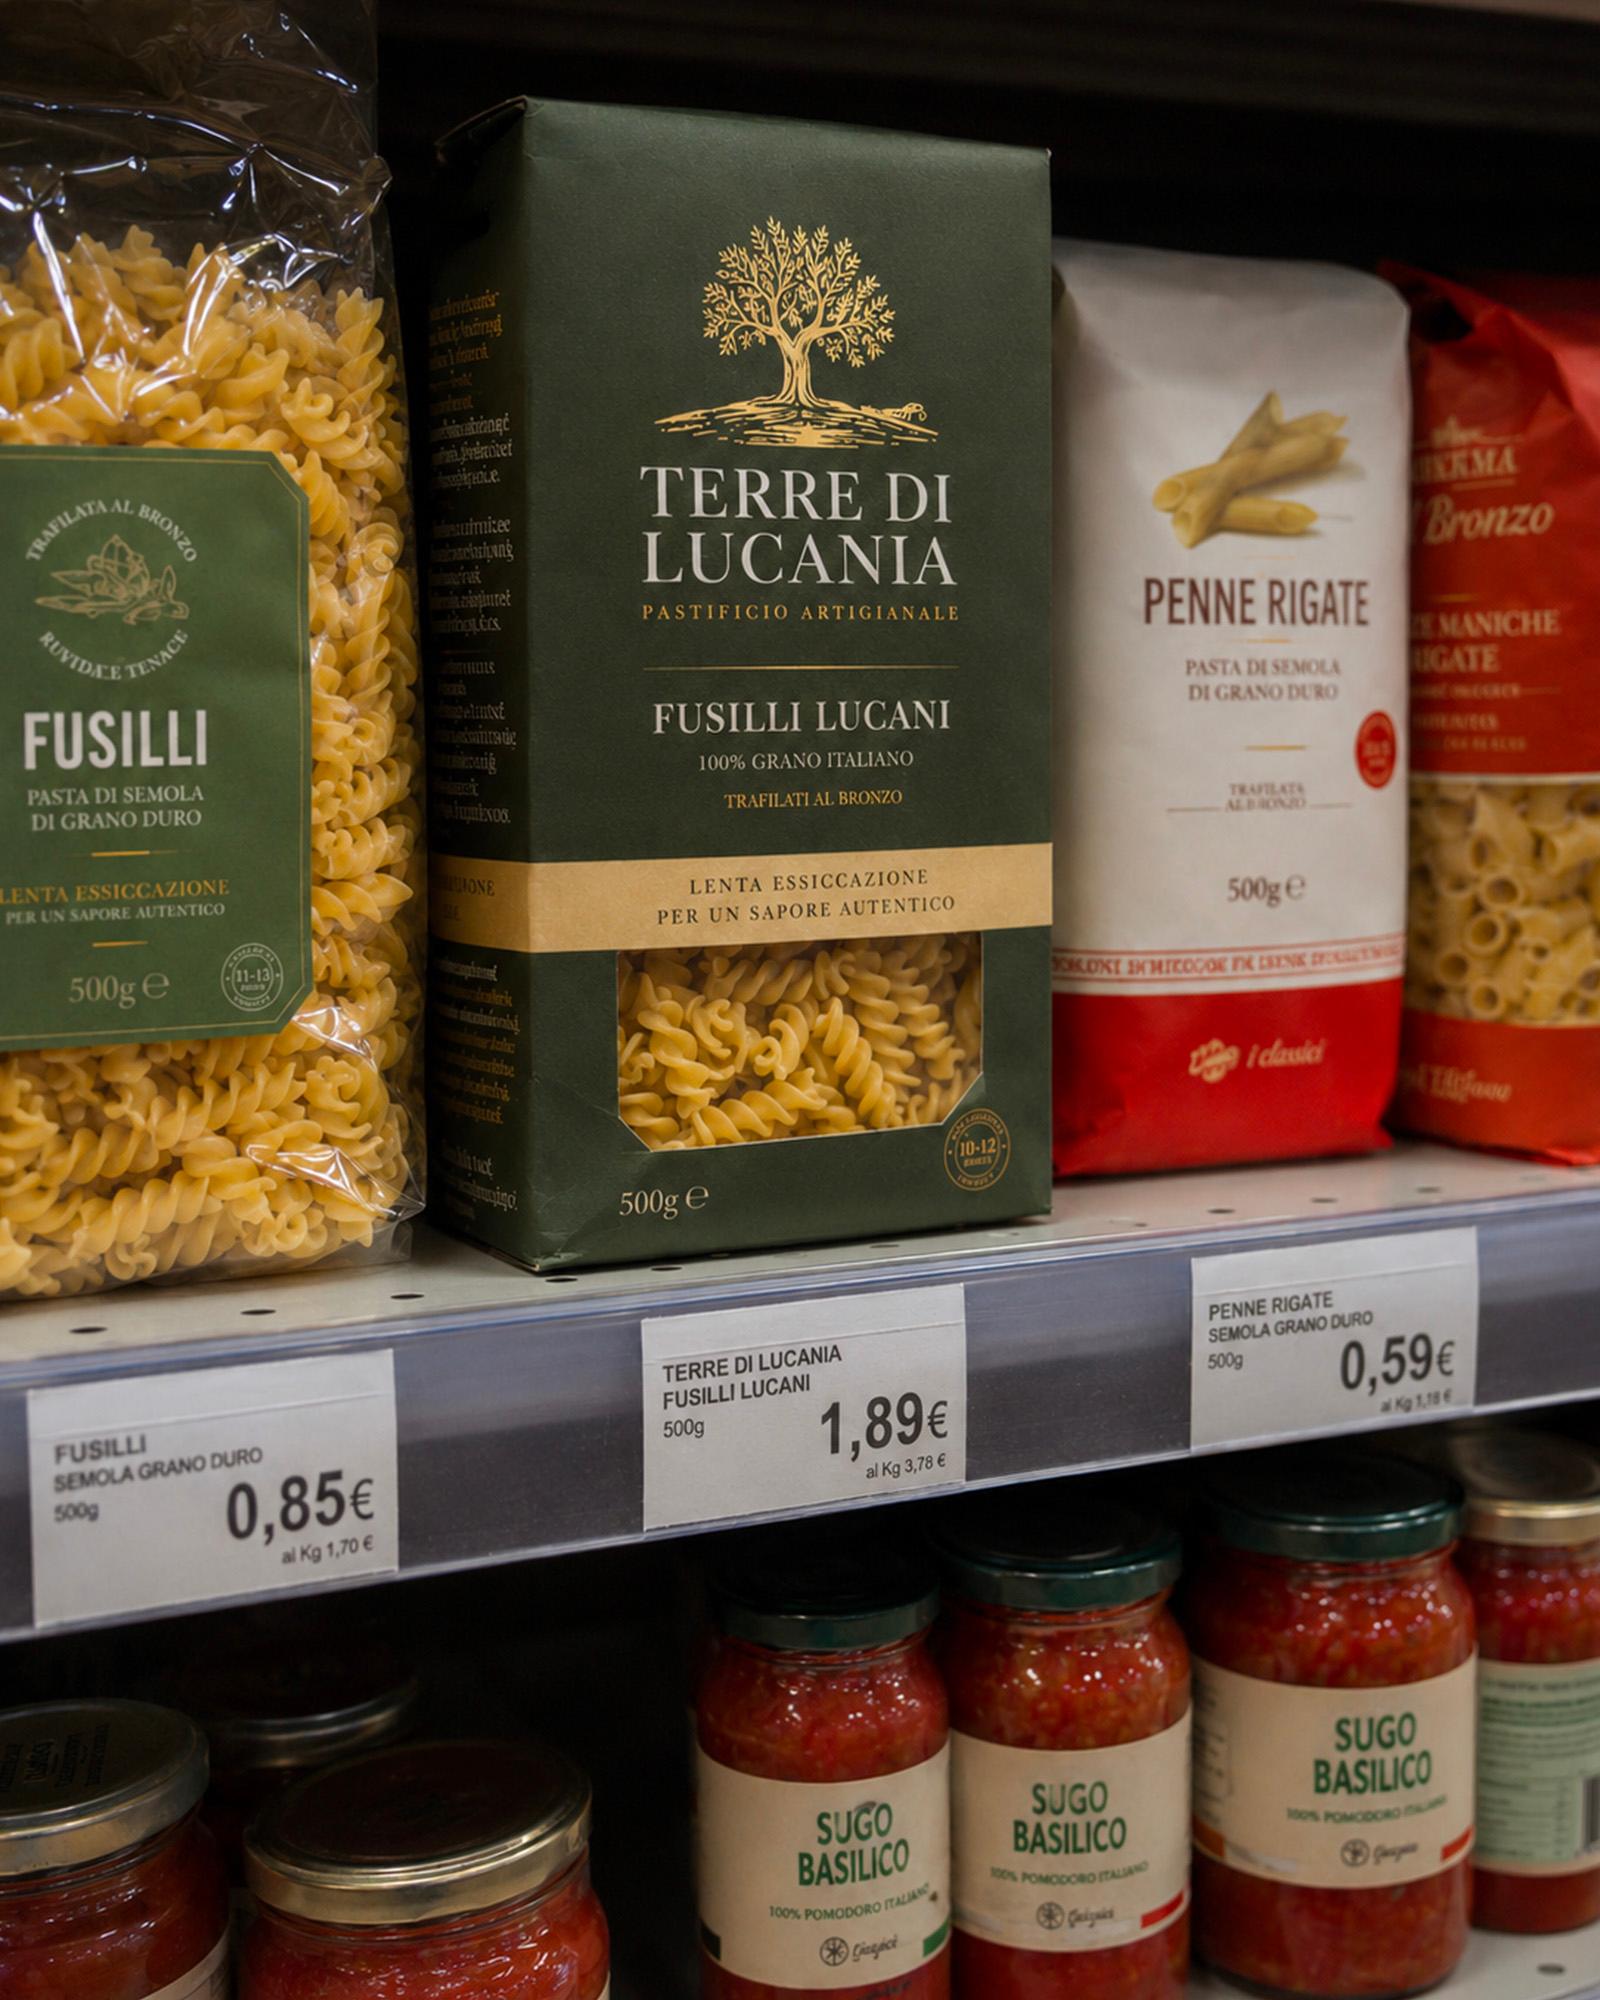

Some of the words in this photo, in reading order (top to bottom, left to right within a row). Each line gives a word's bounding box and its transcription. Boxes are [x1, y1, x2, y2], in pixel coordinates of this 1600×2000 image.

[640, 466, 863, 521] TERRE
[885, 473, 952, 523] DI
[26, 499, 108, 561] TRAFILATA
[110, 499, 134, 514] AL
[138, 504, 197, 562] BRONZO
[1424, 493, 1554, 545] Bronzo
[642, 531, 958, 586] LUCANIA
[642, 604, 789, 620] PASTIFICIO
[801, 605, 959, 621] ARTIGIANALE
[1144, 577, 1256, 626] PENNE
[1268, 579, 1370, 626] RIGATE
[1438, 609, 1562, 639] MANICHE
[125, 629, 188, 680] TENACE
[1185, 659, 1242, 676] PASTA
[1247, 659, 1268, 675] DI
[1271, 658, 1341, 675] SEMOLA
[1188, 684, 1210, 701] DI
[1214, 684, 1283, 701] GRANO
[1287, 683, 1339, 700] DURO
[653, 701, 801, 734] FUSILLI
[816, 699, 950, 732] LUCANI
[24, 709, 207, 770] FUSILLI
[699, 753, 746, 772] 100%
[751, 752, 822, 770] GRANO
[827, 750, 914, 769] ITALIANO
[27, 787, 89, 806] PASTA
[95, 787, 117, 804] DI
[123, 785, 204, 804] SEMOLA
[724, 791, 809, 810] TRAFILATI
[814, 791, 835, 807] AL
[838, 789, 903, 806] BRONZO
[31, 813, 54, 831] DI
[61, 811, 137, 829] GRANO
[142, 808, 202, 826] DURO
[0, 886, 68, 904] LENTA
[76, 879, 230, 901] ESSICCAZIONE
[689, 878, 762, 895] LENTA
[773, 868, 928, 892] ESSICCAZIONE
[1227, 876, 1281, 908] 500g
[6, 911, 37, 925] PER
[42, 909, 65, 923] UN
[70, 906, 131, 922] SAPORE
[135, 903, 225, 919] AUTENTICO
[657, 907, 699, 925] PER
[709, 906, 740, 923] UN
[750, 902, 831, 922] SAPORE
[839, 895, 955, 916] AUTENTICO
[69, 976, 136, 1009] 500g
[619, 1188, 679, 1220] 500g
[1208, 1299, 1267, 1321] PENNE
[1272, 1291, 1334, 1314] RIGATE
[1208, 1319, 1271, 1343] SEMOLA
[1274, 1315, 1327, 1335] GRANO
[1331, 1310, 1374, 1329] DURO
[663, 1358, 729, 1383] TERRE
[735, 1355, 753, 1375] DI
[758, 1344, 842, 1371] LUCANIA
[1208, 1352, 1244, 1370] 500g
[663, 1383, 735, 1410] FUSILLI
[741, 1374, 810, 1399] LUCANI
[663, 1419, 705, 1439] 500g
[54, 1435, 147, 1464] FUSILLI
[54, 1465, 134, 1493] SEMOLA
[139, 1456, 206, 1480] GRANO
[211, 1447, 263, 1471] DURO
[866, 1463, 878, 1479] al
[882, 1460, 901, 1478] Kg
[904, 1455, 934, 1474] 3,78
[54, 1502, 99, 1522] 500g
[282, 1548, 295, 1564] al
[300, 1545, 322, 1563] Kg
[1335, 1712, 1417, 1752] SUGO
[1314, 1750, 1432, 1795] BASILICO
[1032, 1781, 1108, 1816] SUGO
[816, 1803, 893, 1845] SUGO
[1013, 1817, 1127, 1855] BASILICO
[798, 1838, 910, 1886] BASILICO
[1021, 1872, 1097, 1886] POMODORO
[769, 1906, 801, 1920] 100%
[804, 1902, 882, 1921] POMODORO
